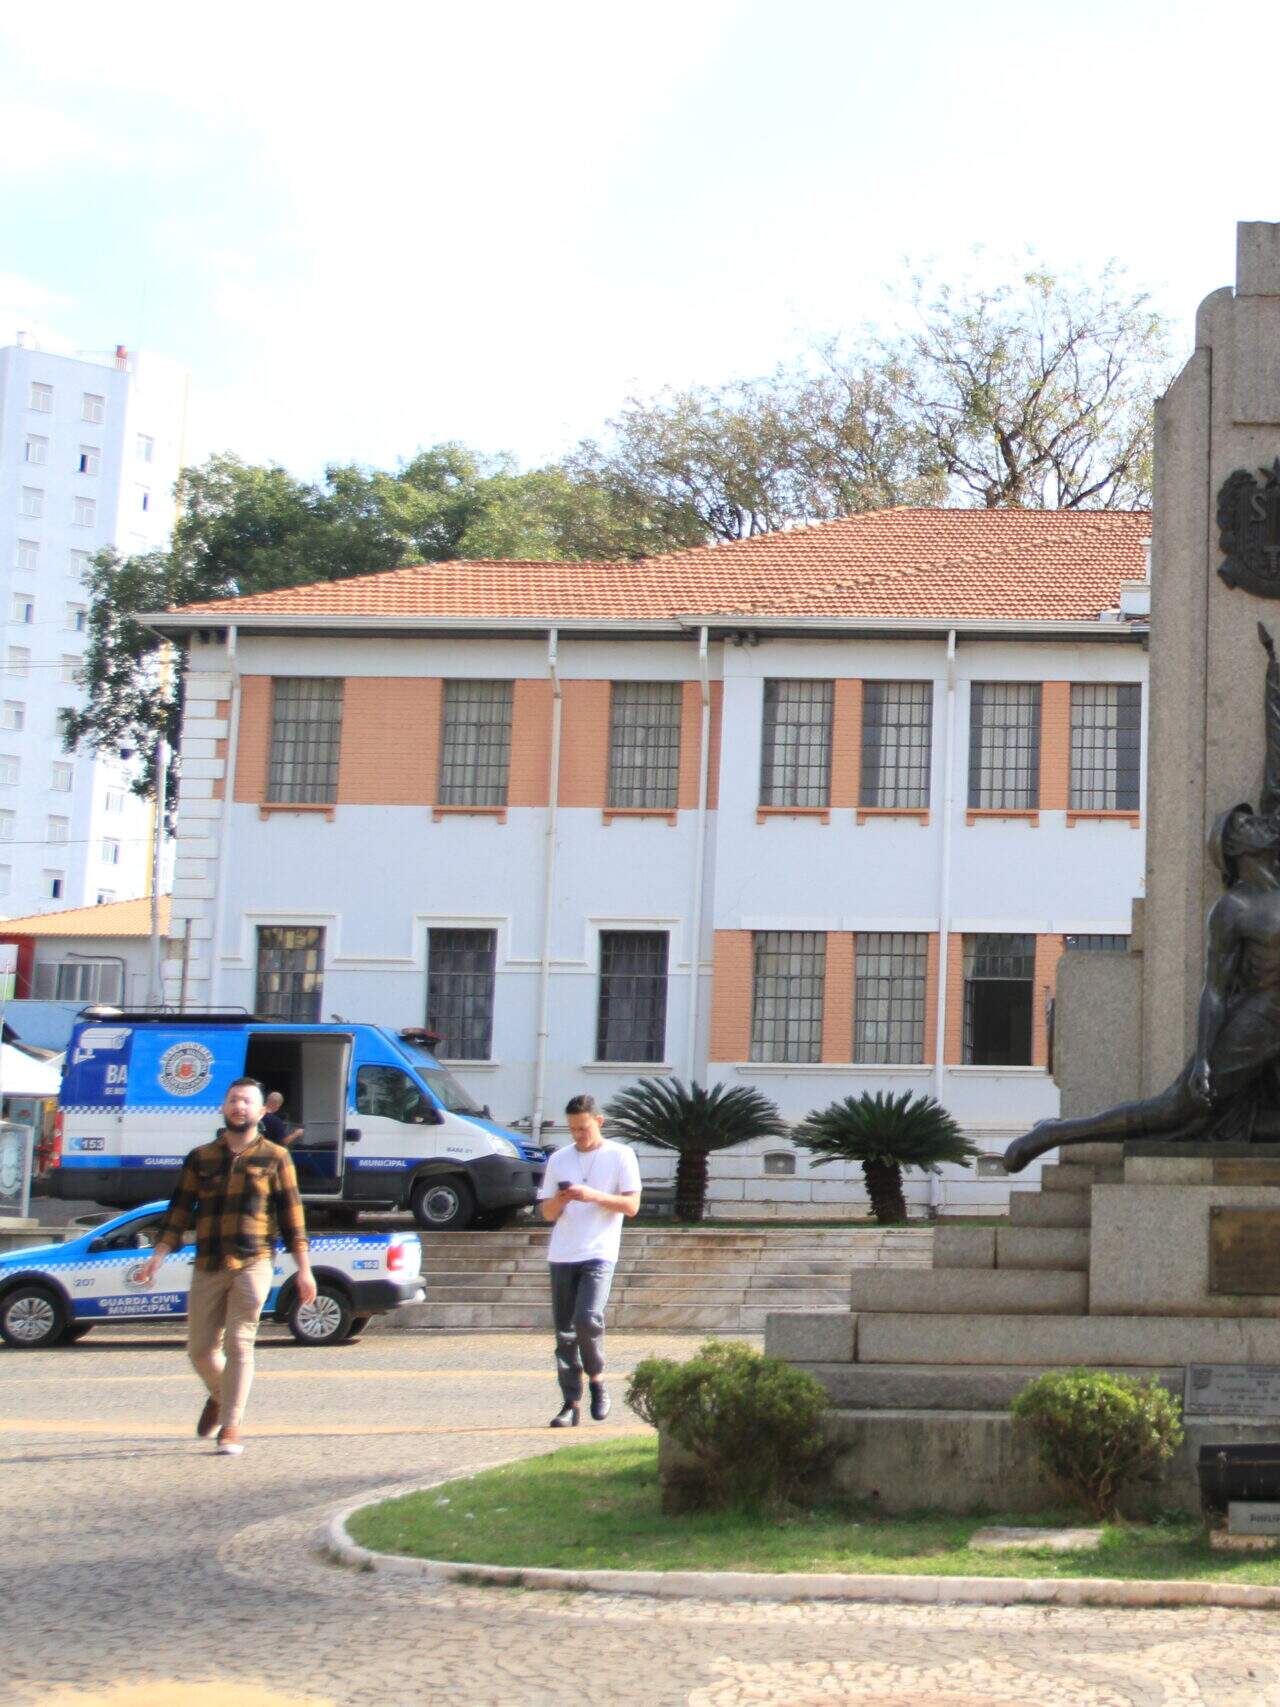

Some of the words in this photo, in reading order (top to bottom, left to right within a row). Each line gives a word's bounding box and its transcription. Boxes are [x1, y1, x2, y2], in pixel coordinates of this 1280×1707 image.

[82, 1139, 104, 1149] 153
[144, 1157, 183, 1166] GUARDA
[99, 1297, 149, 1308] GUARDA
[150, 1295, 182, 1304] CIVIL
[107, 1304, 173, 1314] MUNICIPAL
